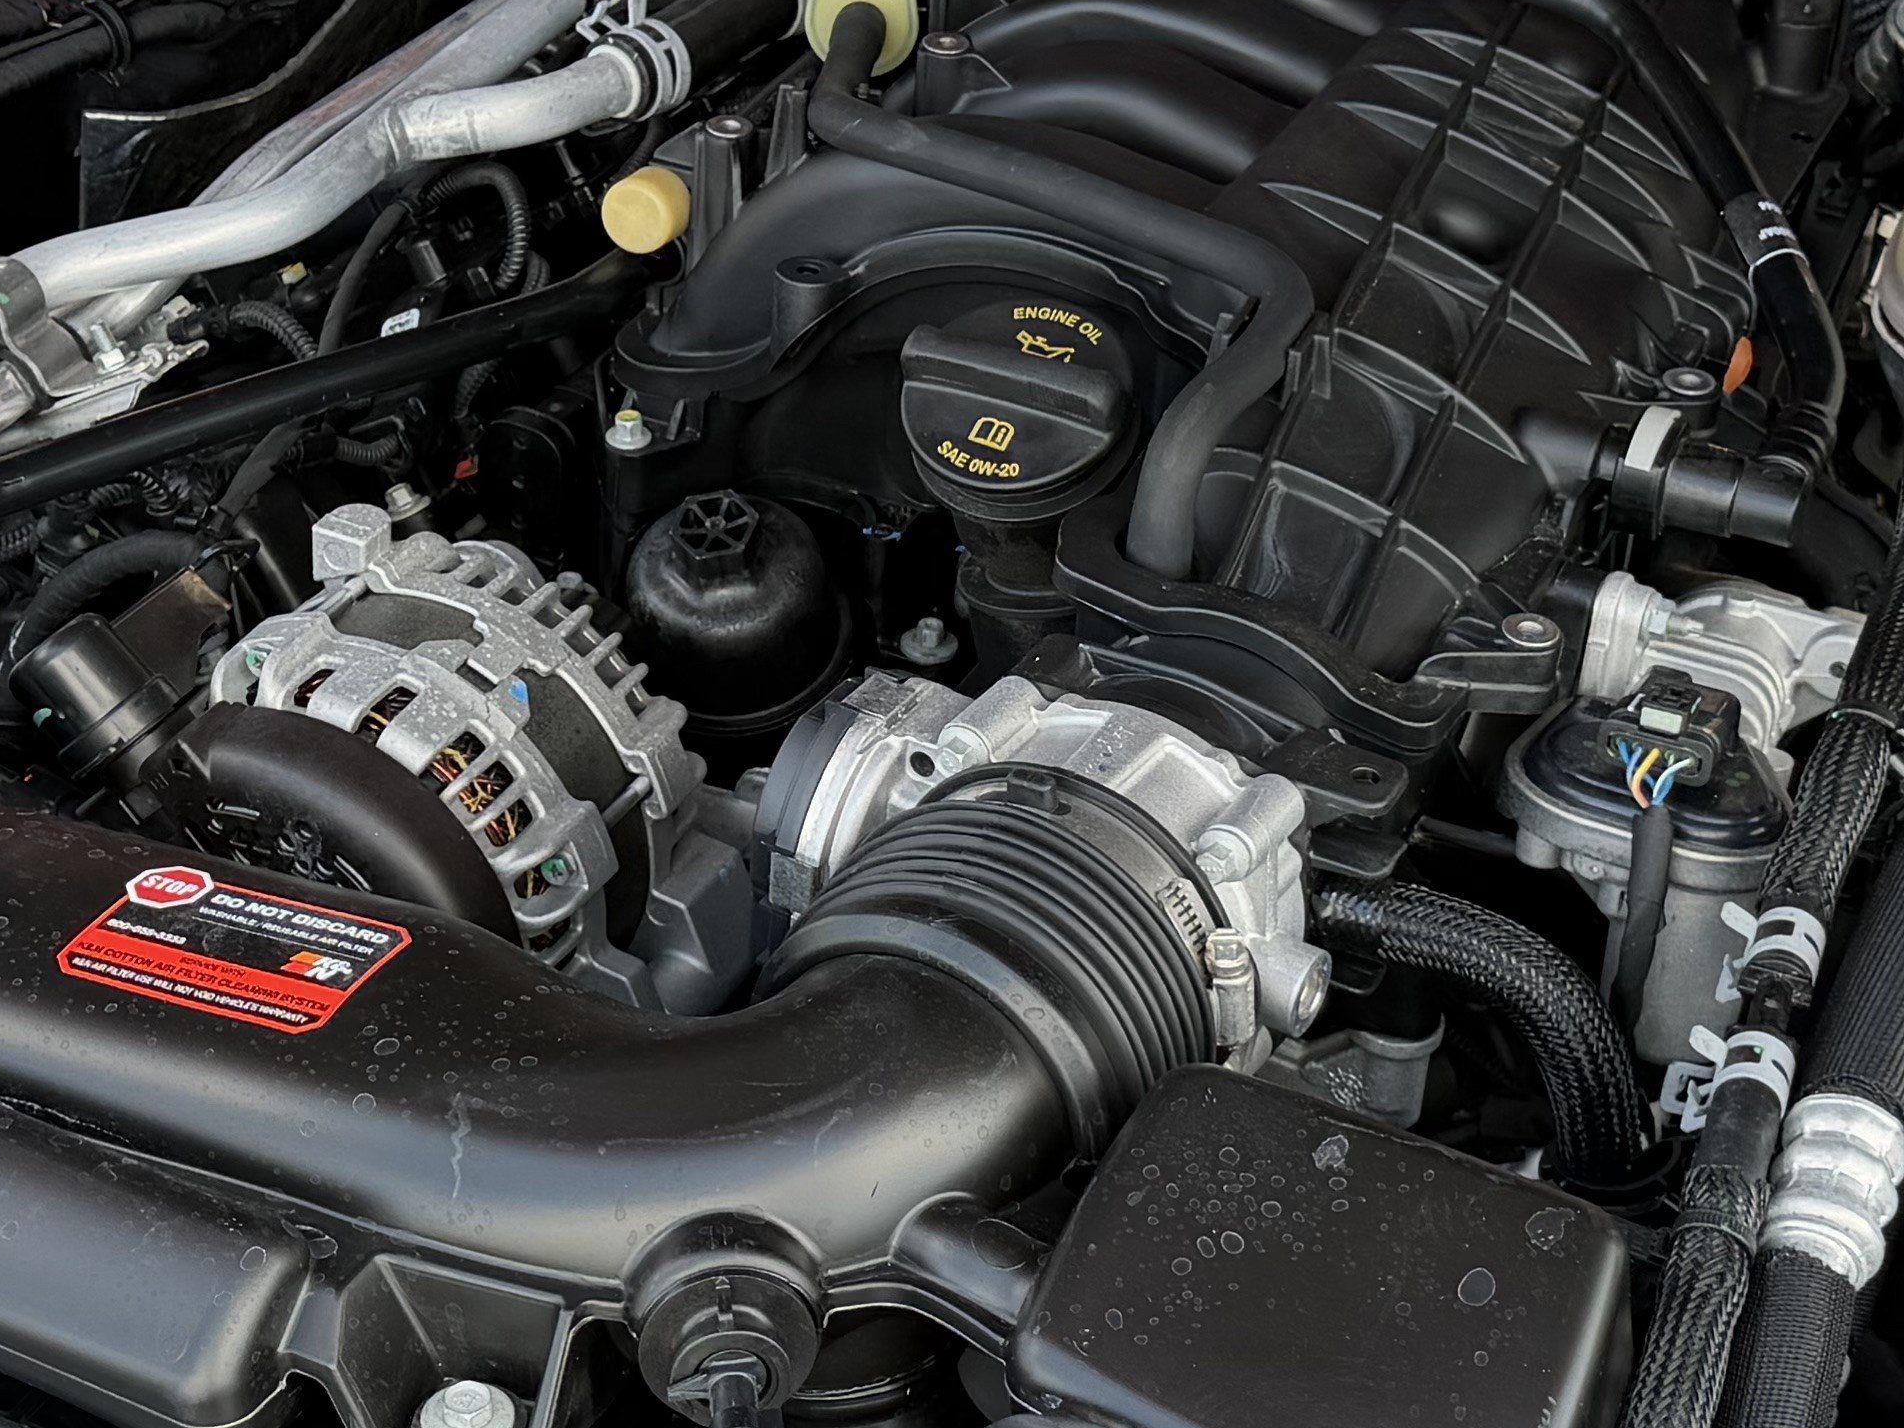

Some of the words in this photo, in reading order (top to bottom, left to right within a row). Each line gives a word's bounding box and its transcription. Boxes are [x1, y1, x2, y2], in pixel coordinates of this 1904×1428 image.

[1013, 306, 1081, 328] ENGINE
[1078, 322, 1103, 346] OIL
[937, 440, 971, 469] SAE
[968, 458, 1020, 477] 0W-20
[140, 873, 199, 896] STOP
[210, 893, 246, 909] DO
[243, 902, 294, 920] NOT
[290, 914, 390, 944] DISCARD
[317, 936, 339, 946] AIR
[337, 940, 374, 955] FILTER
[104, 948, 156, 968] COTTON
[153, 960, 178, 975] AIR
[176, 967, 218, 983] FILTER
